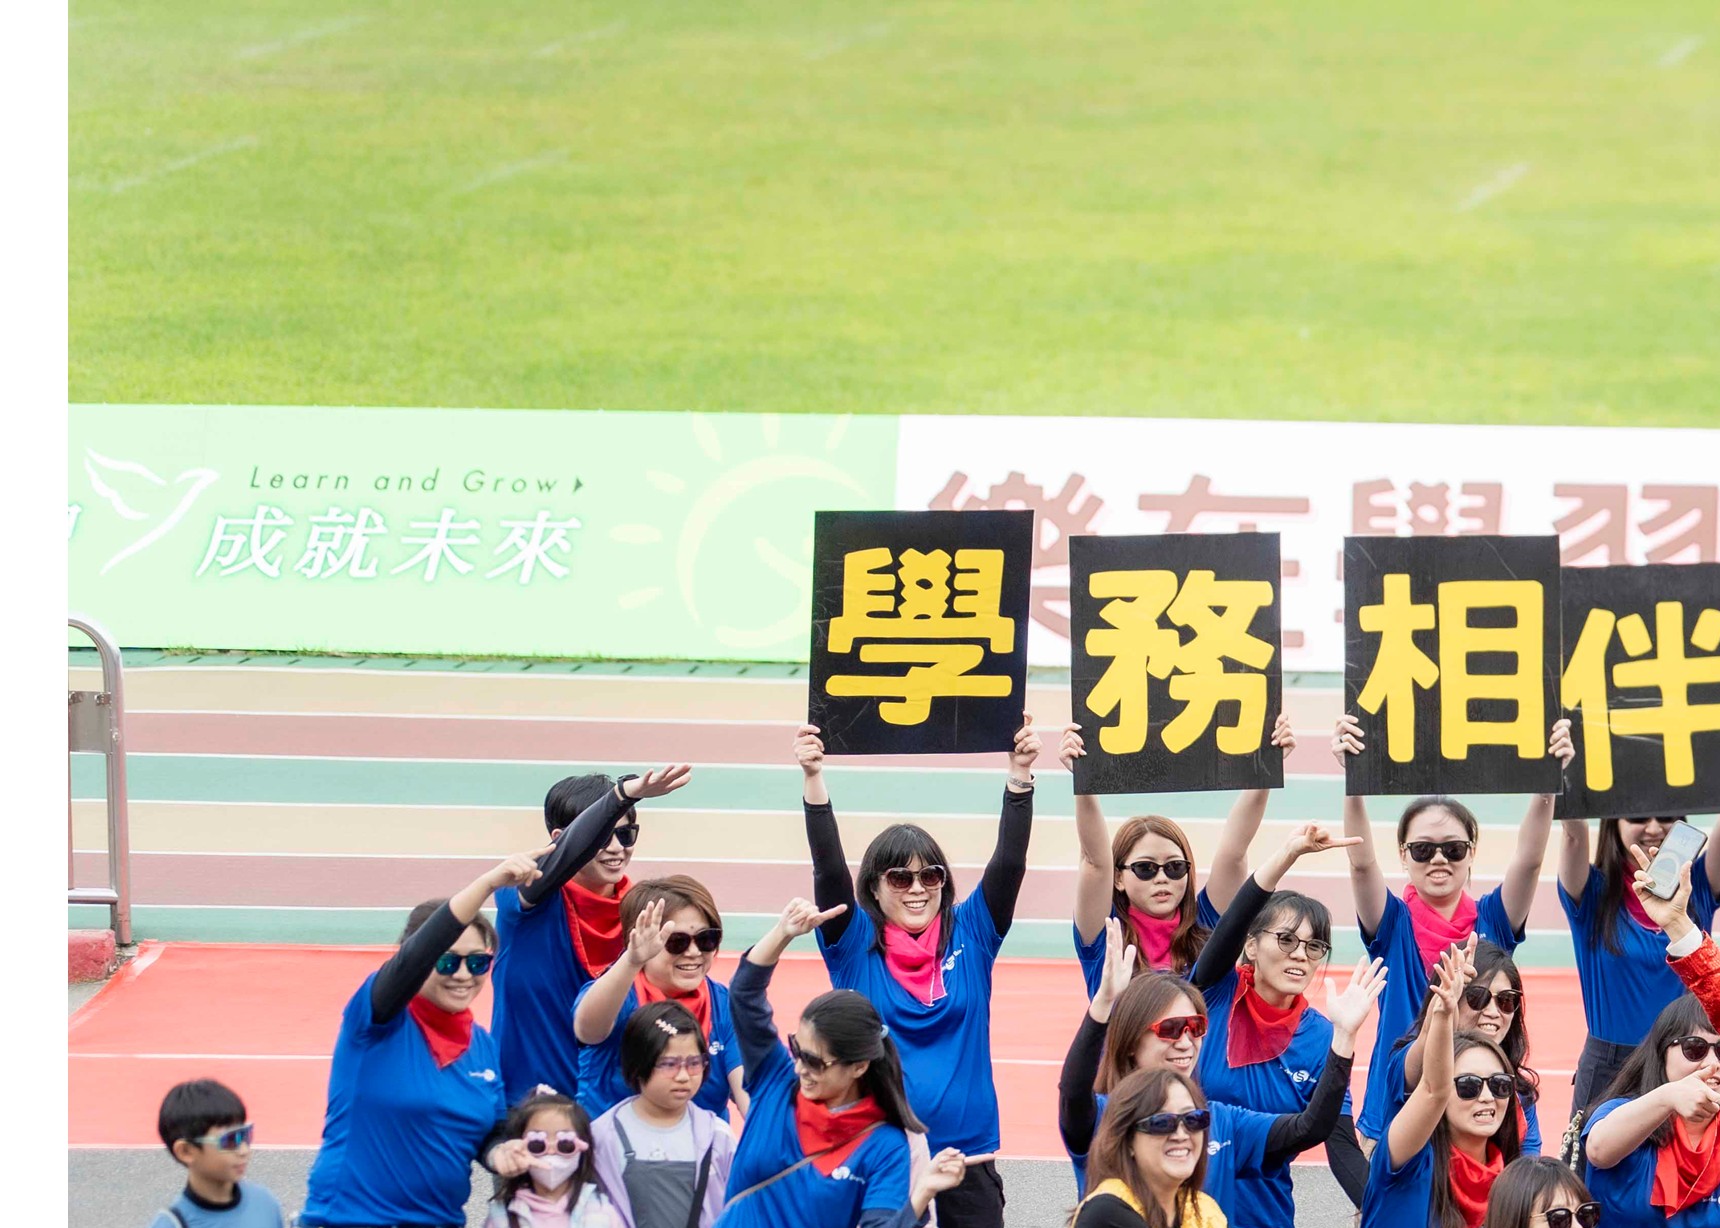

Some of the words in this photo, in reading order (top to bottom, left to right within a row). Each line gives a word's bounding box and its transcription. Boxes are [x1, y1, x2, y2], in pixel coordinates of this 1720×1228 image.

[195, 505, 582, 585] 成就未來
[249, 466, 349, 492] Learn
[373, 467, 438, 493] and
[463, 469, 559, 495] Grow
[825, 547, 1015, 726] 學
[1084, 569, 1273, 755] 務
[1357, 573, 1545, 763] 相
